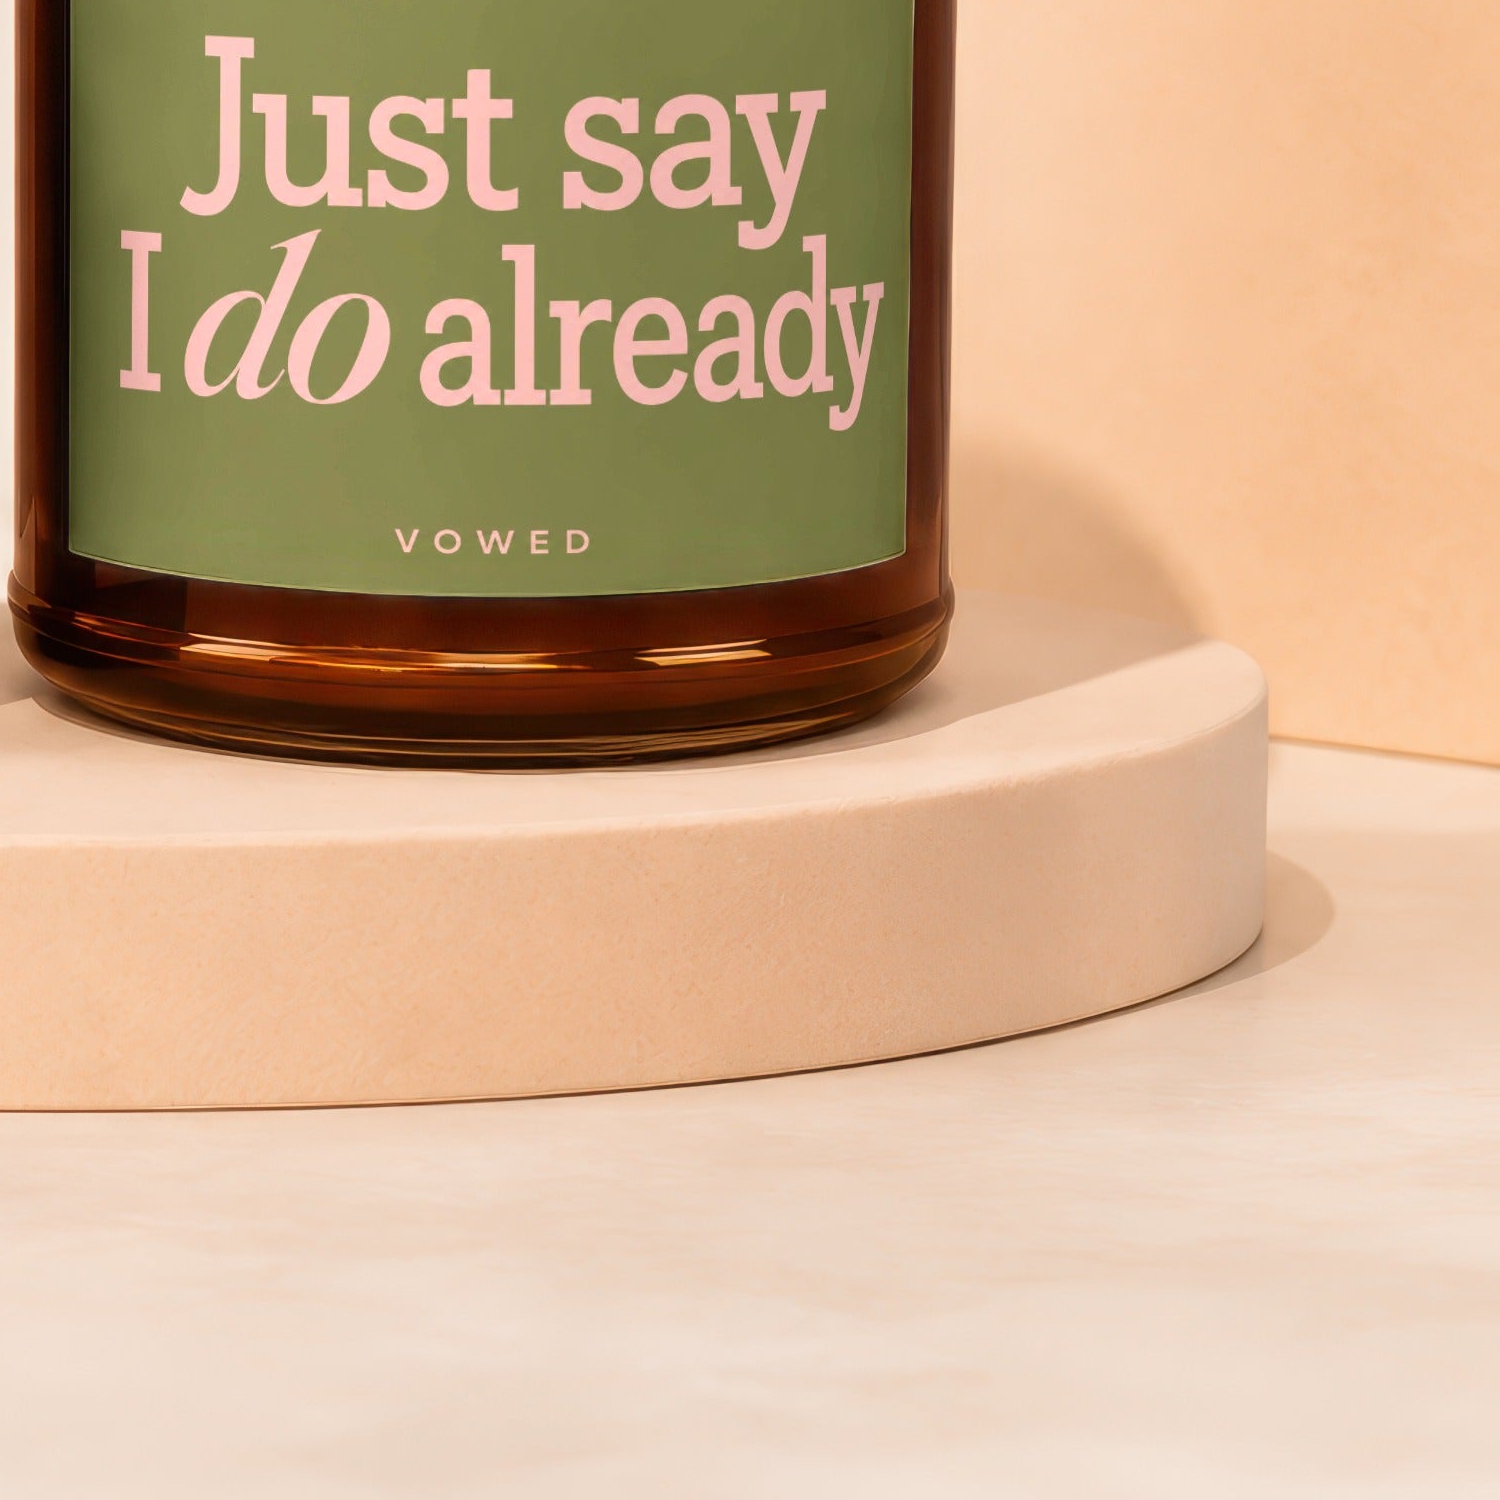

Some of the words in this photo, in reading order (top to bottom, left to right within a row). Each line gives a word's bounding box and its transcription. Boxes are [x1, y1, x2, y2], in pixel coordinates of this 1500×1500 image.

[179, 34, 519, 217] Just
[562, 89, 828, 250] say
[119, 230, 162, 392] I
[183, 228, 391, 405] do
[418, 234, 885, 432] already
[394, 527, 591, 555] VOWED
